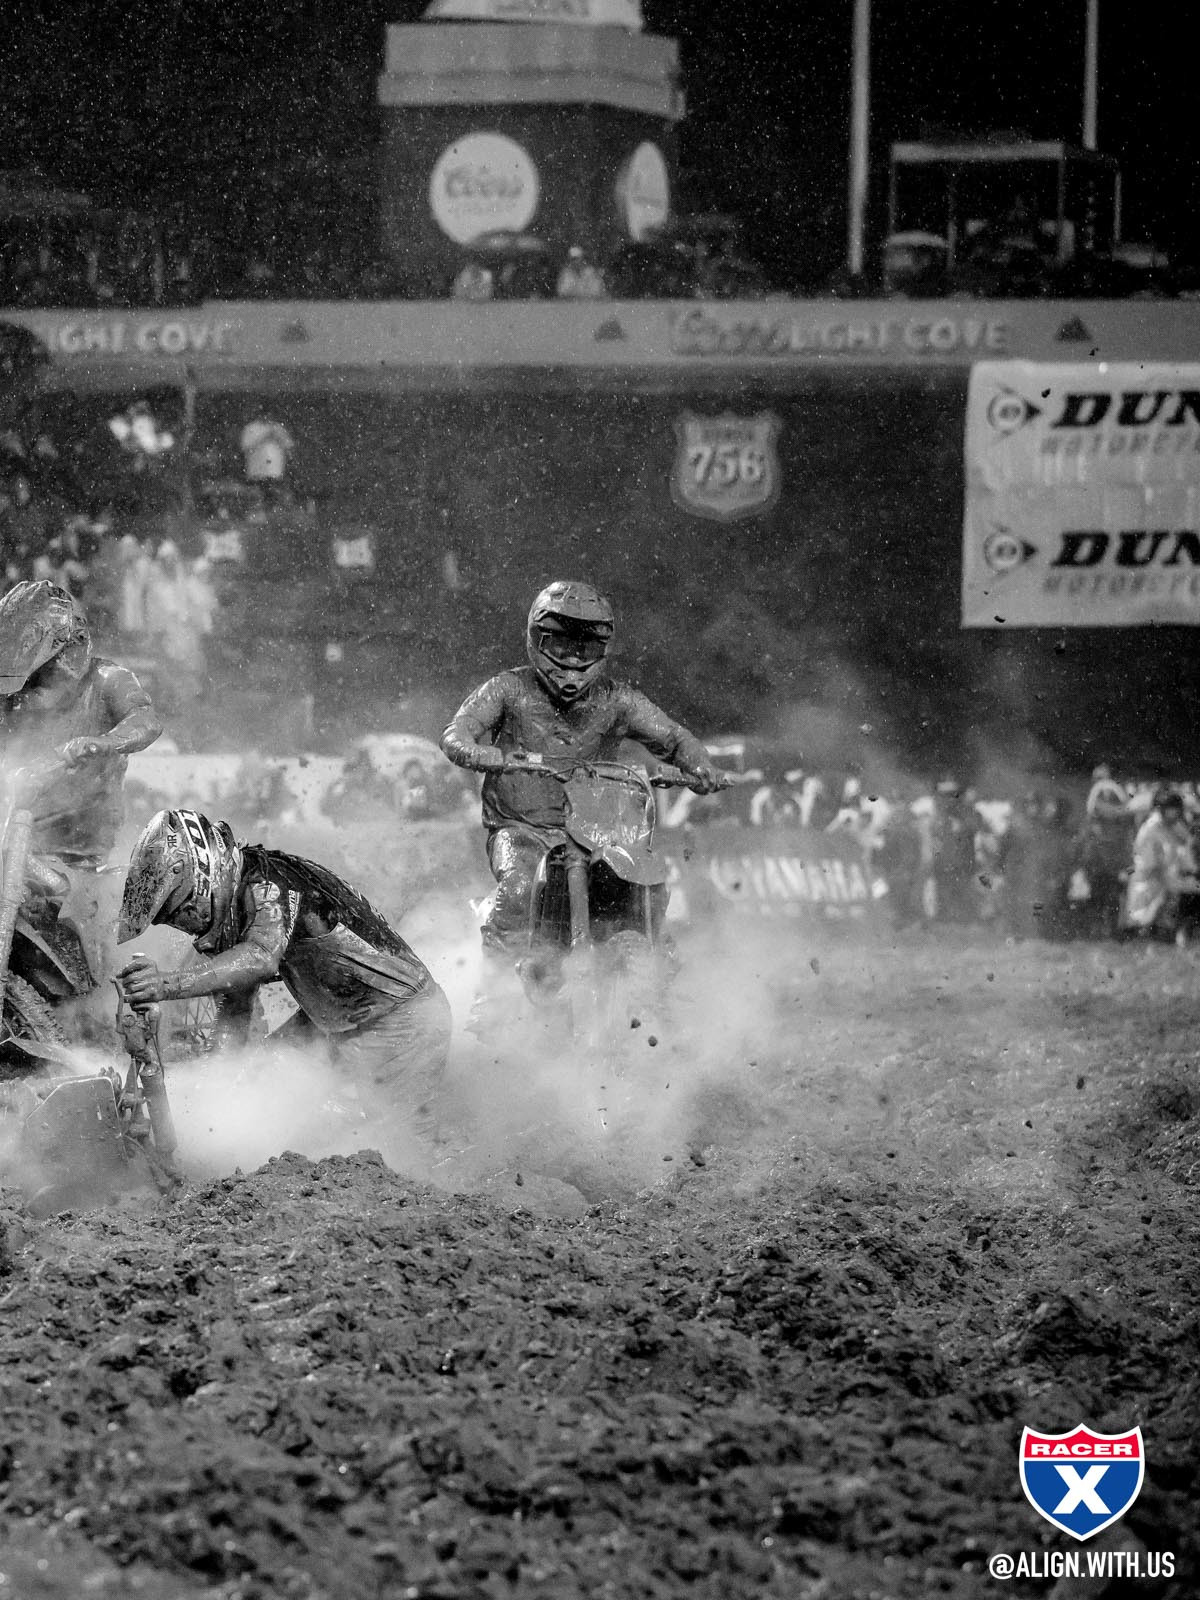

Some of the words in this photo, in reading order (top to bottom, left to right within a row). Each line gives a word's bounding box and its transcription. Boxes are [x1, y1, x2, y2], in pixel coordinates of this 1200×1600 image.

[903, 319, 1008, 351] COVE
[1050, 390, 1200, 429] DUN
[1050, 530, 1200, 569] DUN
